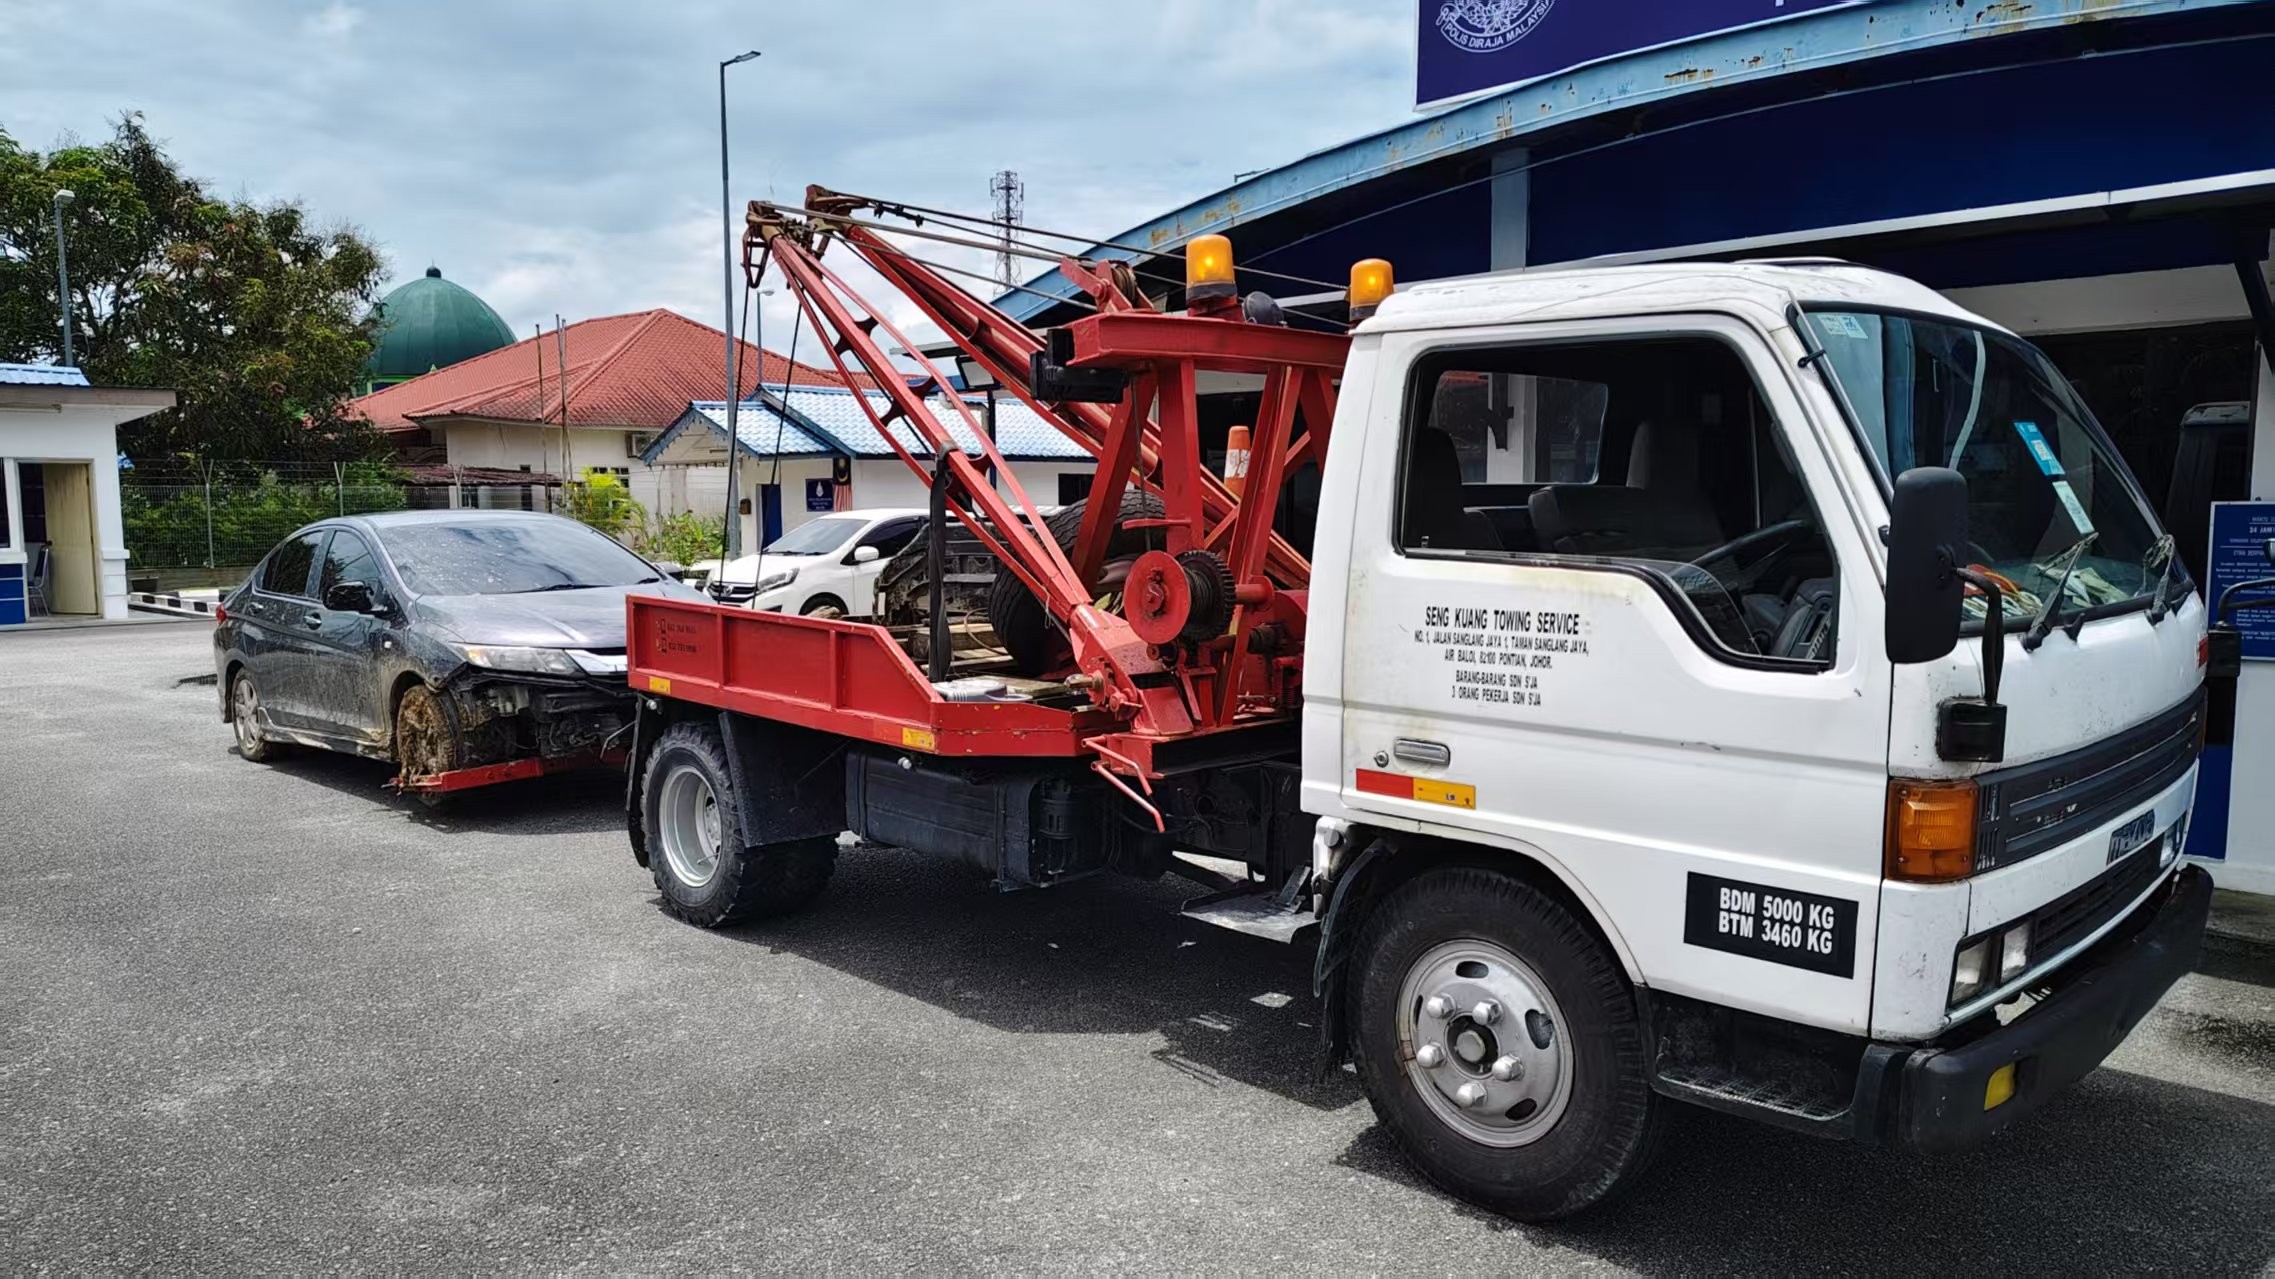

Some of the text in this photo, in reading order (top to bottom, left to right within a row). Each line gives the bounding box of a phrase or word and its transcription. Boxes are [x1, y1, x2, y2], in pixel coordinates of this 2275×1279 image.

[1445, 22, 1468, 45] POLIS
[1468, 36, 1504, 48] DIRAJA
[1425, 605, 1580, 635] SENG KUANG TOWING SERVICE
[1433, 630, 1451, 645] JALAN
[1453, 632, 1484, 647] SANGLANG
[1486, 634, 1501, 648] JAYA
[1512, 636, 1532, 650] TAMAN
[1534, 637, 1568, 653] SANGLANG
[1570, 639, 1589, 656] JAYA,
[1445, 648, 1455, 661] AIR
[1456, 669, 1506, 687] BARANG-BARANG
[1459, 686, 1479, 700] ORANG
[1482, 688, 1509, 703] PEKERJA
[1720, 887, 1834, 929] BDM 5000 KG
[1718, 911, 1833, 955] BTM 3460 KG
